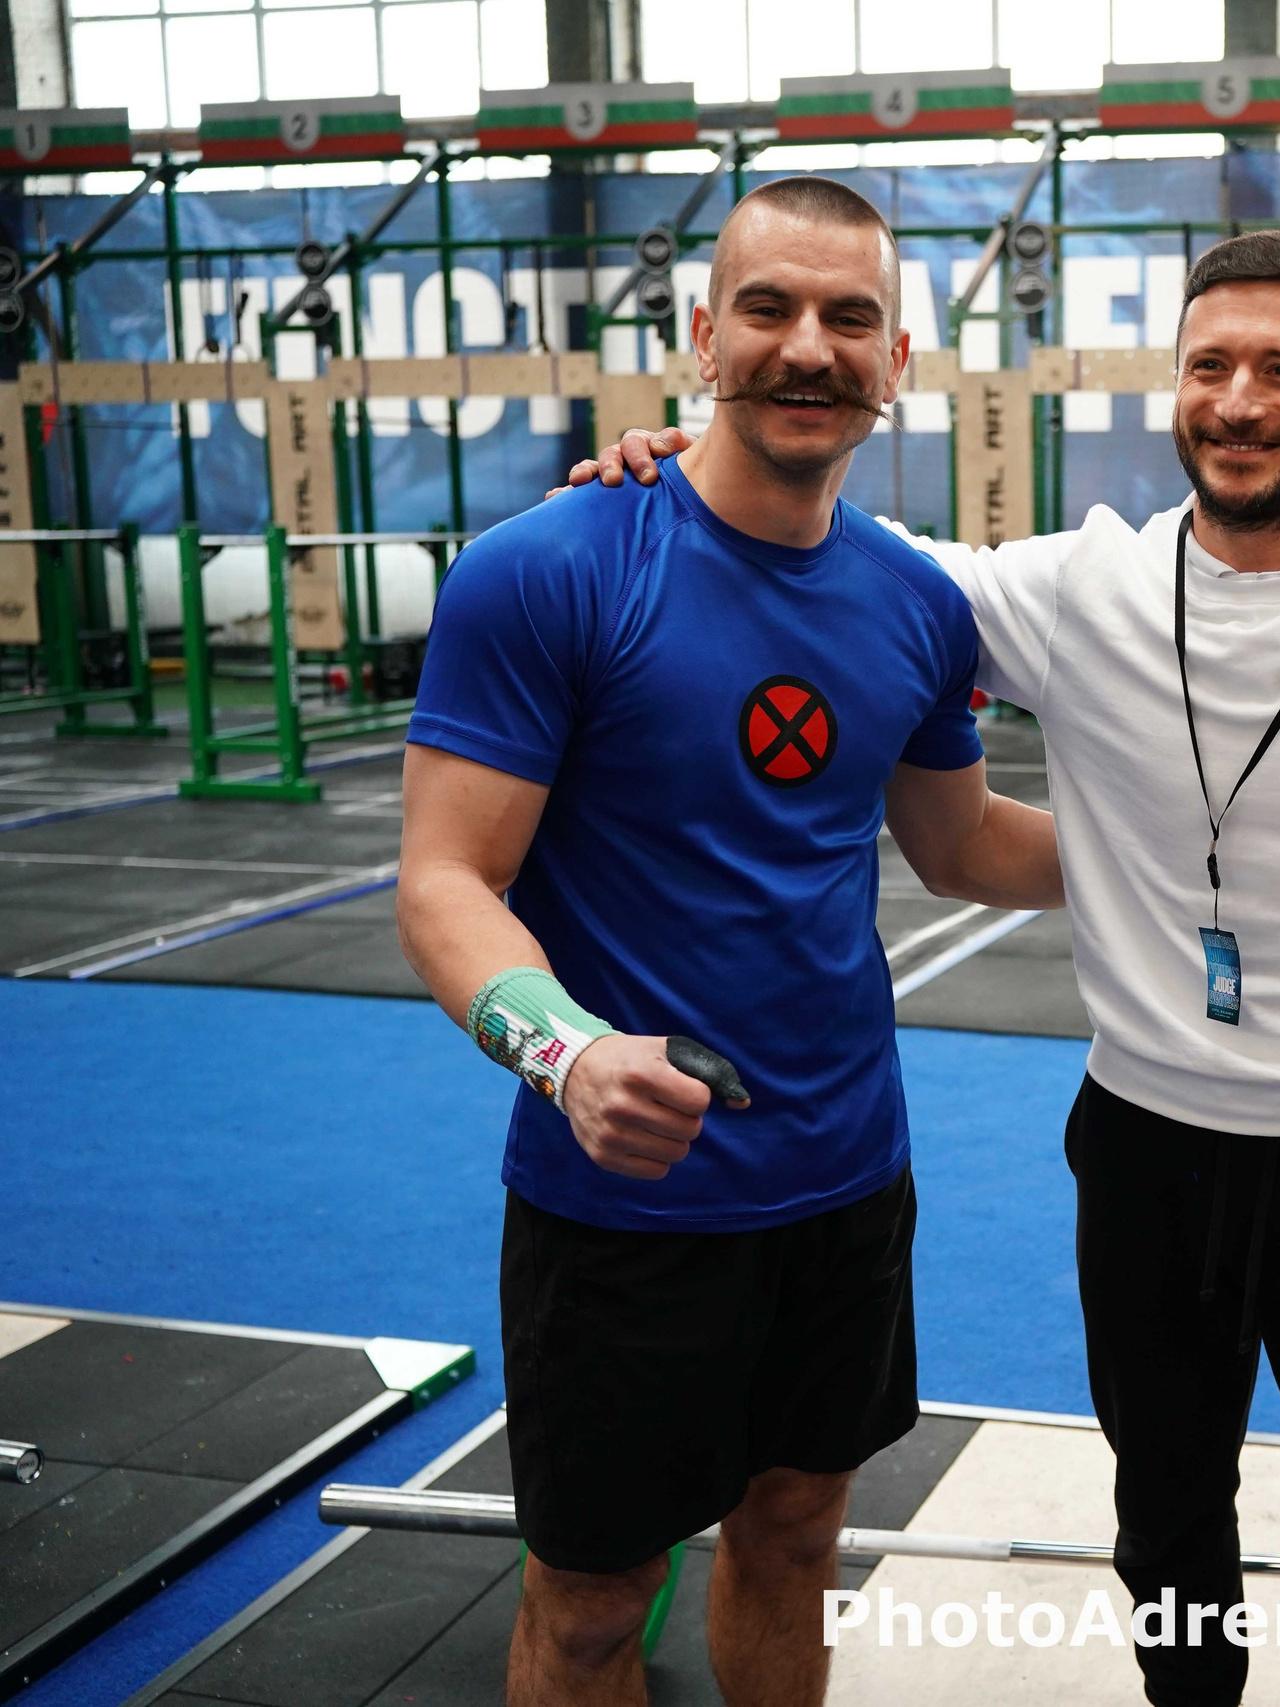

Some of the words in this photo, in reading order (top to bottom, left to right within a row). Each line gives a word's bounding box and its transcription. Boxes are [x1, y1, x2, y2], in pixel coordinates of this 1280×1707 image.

[885, 89, 903, 113] 4
[1216, 74, 1236, 104] 5
[291, 113, 308, 140] 2
[576, 101, 593, 128] 3
[25, 123, 36, 147] 1
[1213, 975, 1236, 995] JUDGE
